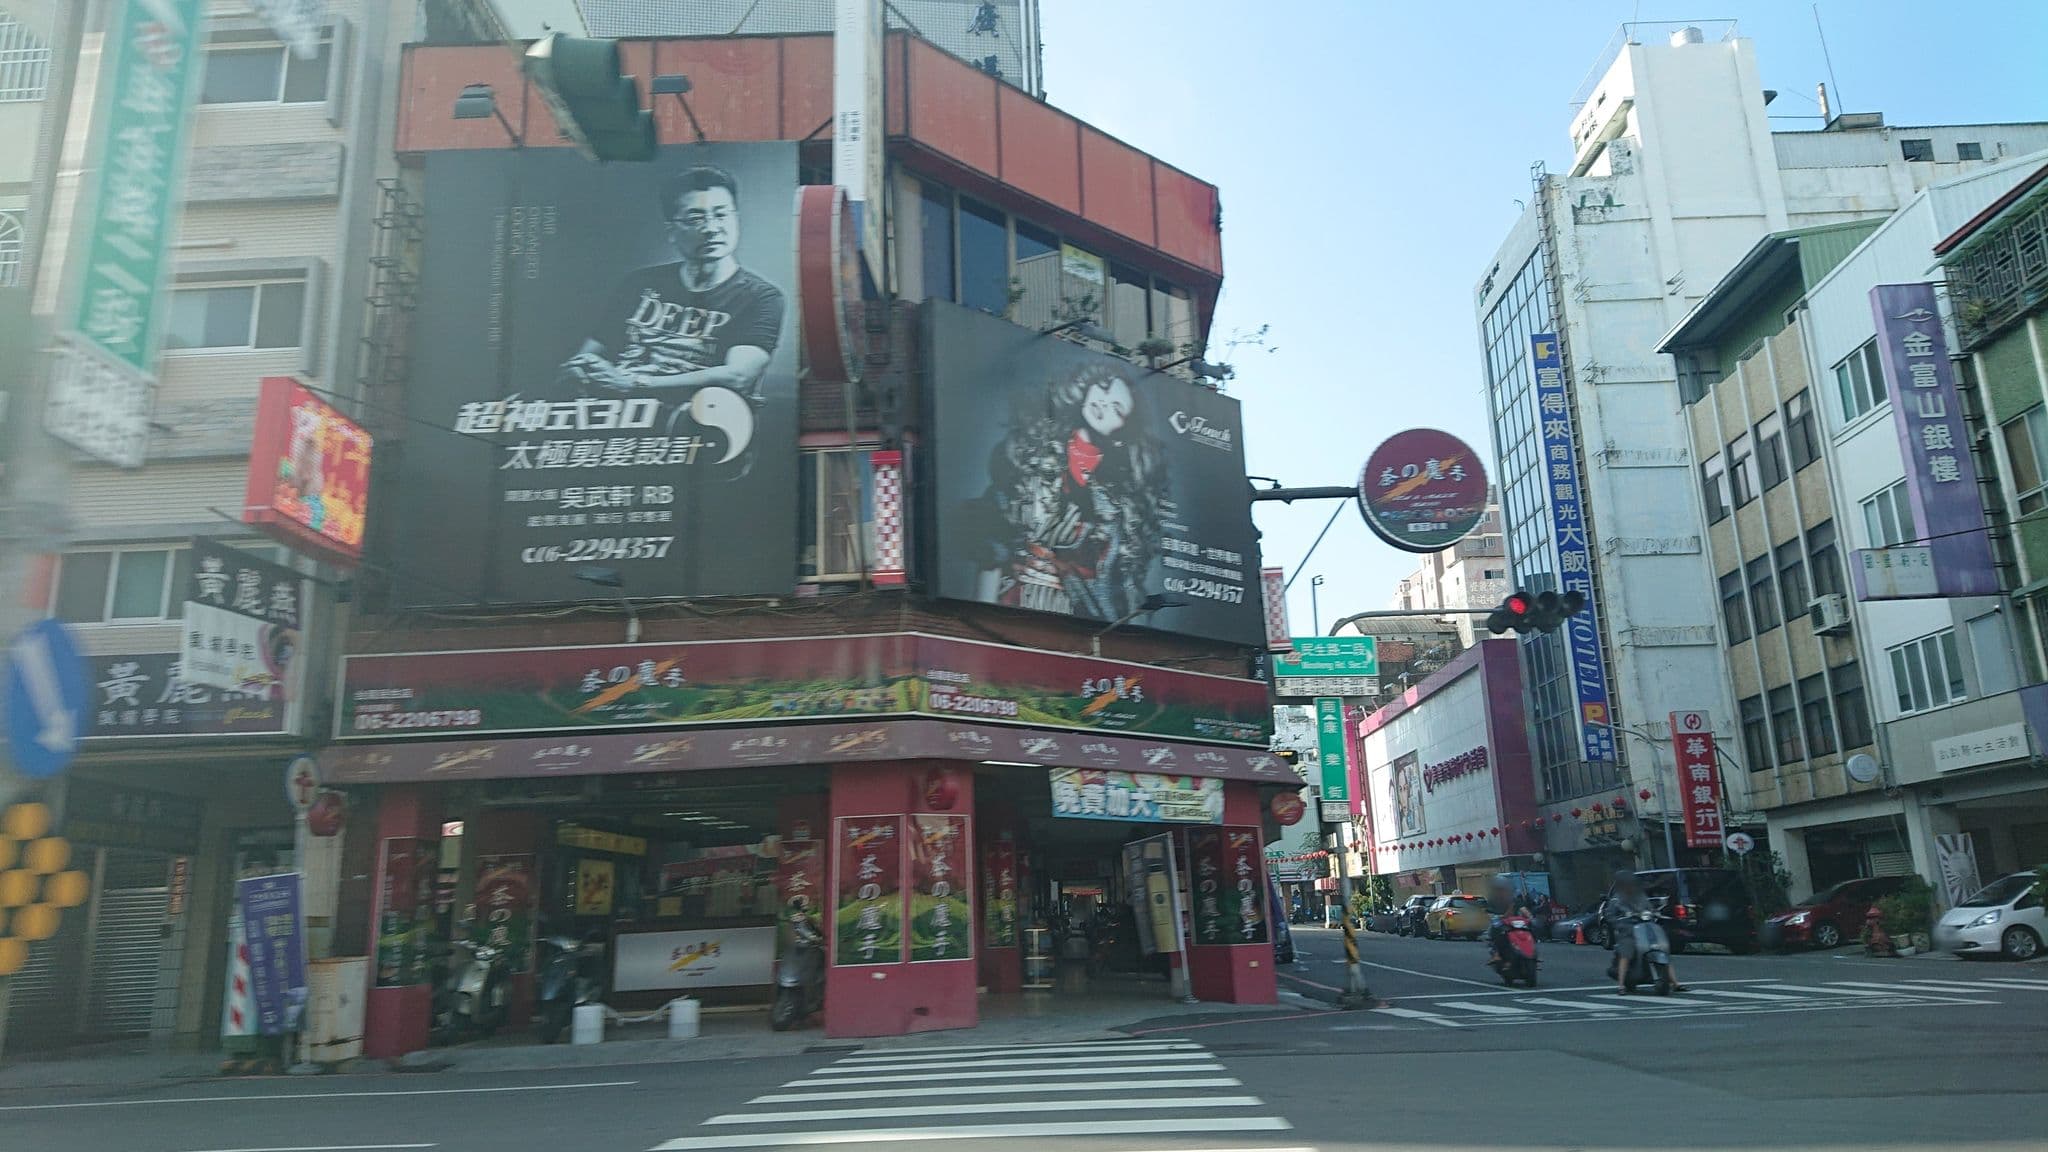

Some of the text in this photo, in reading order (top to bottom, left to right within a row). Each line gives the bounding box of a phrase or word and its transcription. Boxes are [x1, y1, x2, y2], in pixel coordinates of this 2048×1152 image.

[625, 297, 731, 340] DEEP
[1902, 332, 1963, 484] 金富山銀樓
[500, 436, 706, 470] 太極剪髮設計
[559, 485, 635, 508] 吳武軒
[1571, 609, 1601, 696] HOTEL
[1685, 737, 1719, 828] 華南銀行
